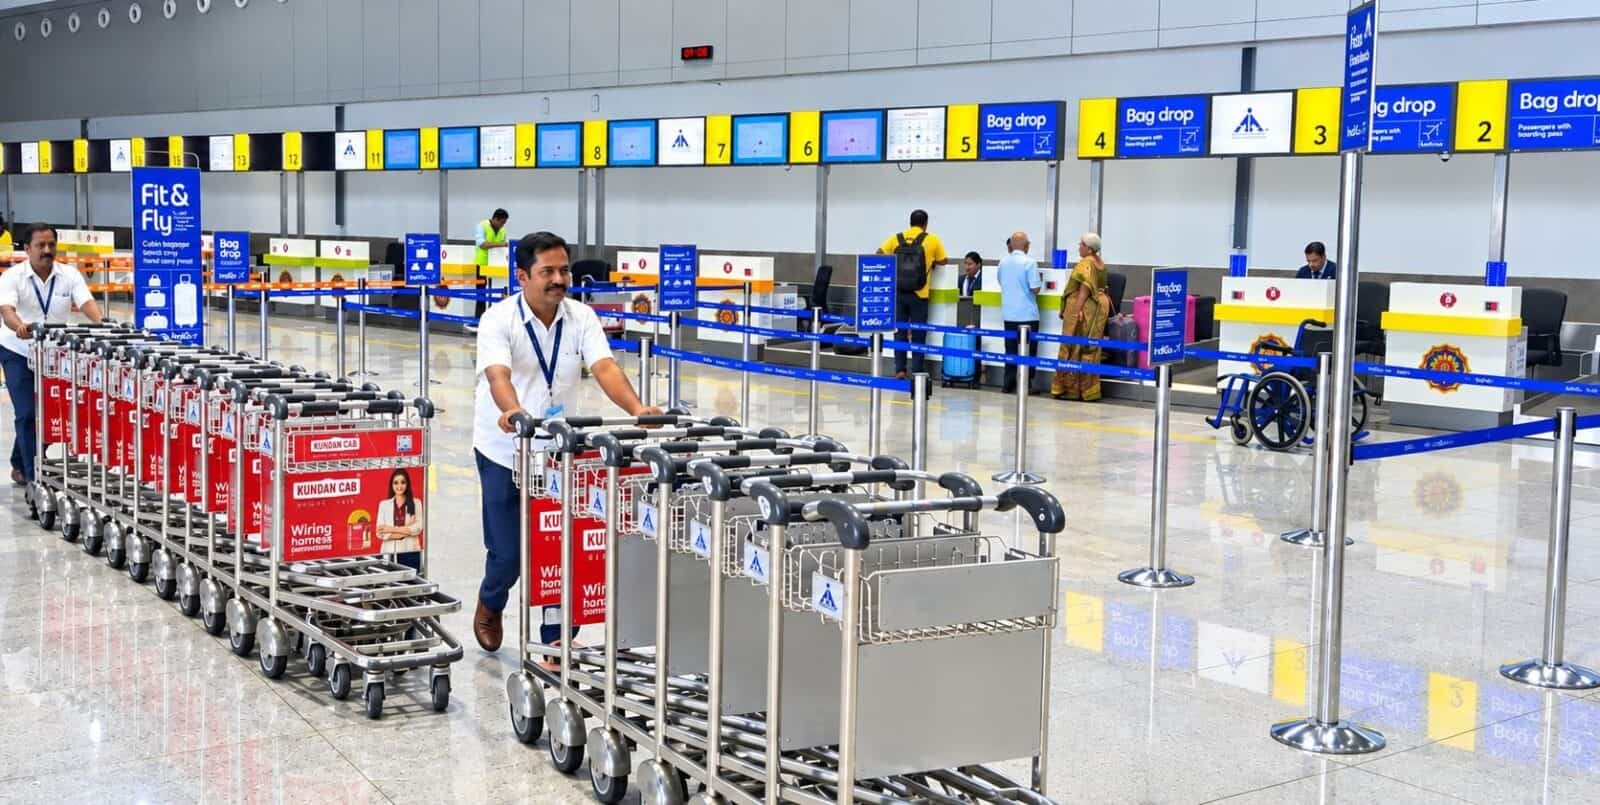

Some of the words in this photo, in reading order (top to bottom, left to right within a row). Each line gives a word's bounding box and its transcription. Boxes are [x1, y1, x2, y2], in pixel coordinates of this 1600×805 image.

[1392, 95, 1437, 117] drop
[1520, 92, 1558, 113] Bag
[987, 113, 1012, 131] Bag
[1015, 112, 1047, 130] drop
[1126, 107, 1155, 126] Bag
[1158, 106, 1194, 126] drop
[1314, 124, 1328, 145] 3
[1477, 121, 1492, 142] 2
[803, 140, 813, 156] 6
[961, 136, 971, 153] 5
[1094, 131, 1106, 150] 4
[371, 152, 380, 164] 11
[424, 151, 435, 163] 10
[524, 147, 531, 161] 9
[594, 146, 601, 160] 8
[717, 143, 726, 158] 7
[142, 209, 172, 236] Fly
[220, 238, 240, 251] Bag
[220, 251, 241, 260] drop
[313, 441, 342, 450] KUNDAN
[297, 485, 336, 496] KUNDAN
[339, 482, 357, 493] CAB
[291, 523, 332, 537] Wiring
